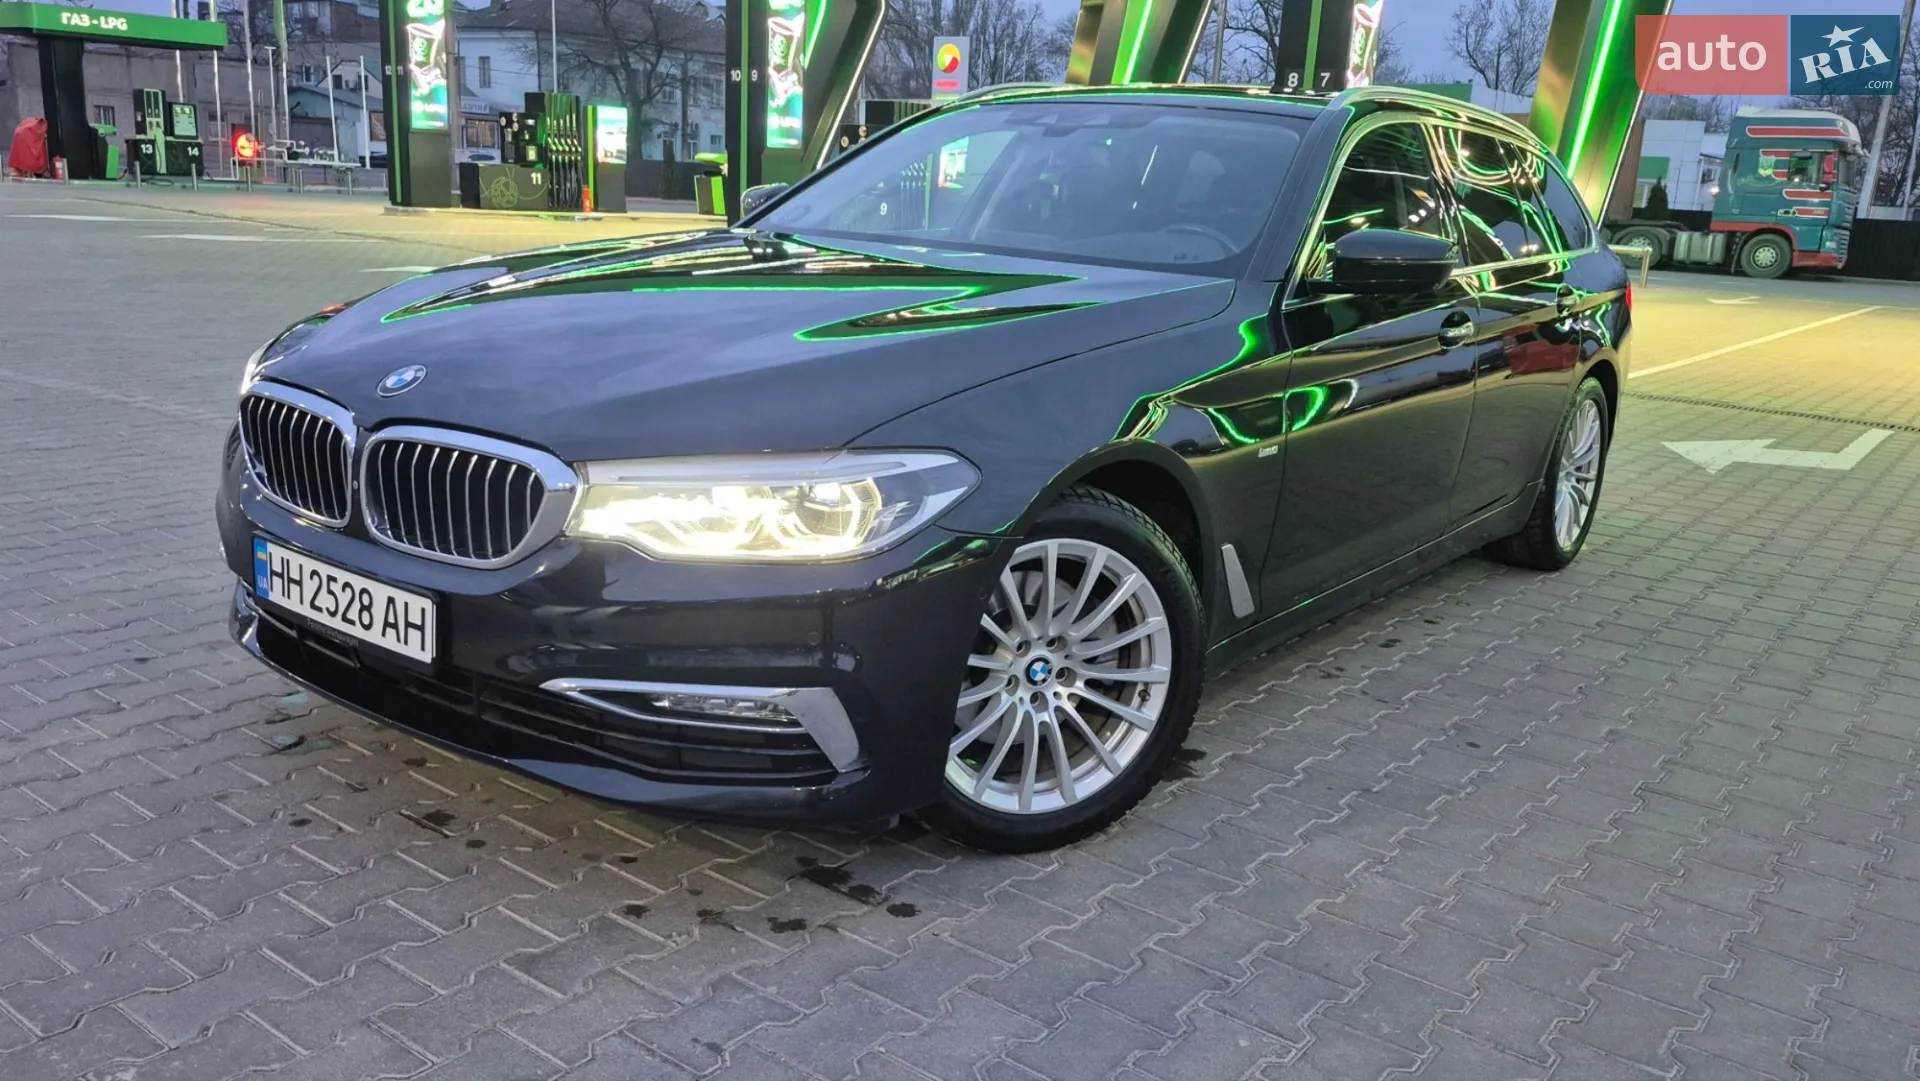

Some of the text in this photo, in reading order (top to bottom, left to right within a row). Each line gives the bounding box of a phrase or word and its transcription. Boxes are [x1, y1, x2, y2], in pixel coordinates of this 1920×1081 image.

[730, 69, 741, 82] 10
[751, 69, 758, 82] 9
[1287, 72, 1299, 87] 8
[1320, 72, 1331, 87] 7
[140, 143, 153, 154] 13
[187, 146, 199, 157] 14
[531, 172, 542, 185] 11
[880, 202, 888, 216] 9
[257, 575, 268, 590] UA
[309, 569, 374, 631] 2528
[381, 595, 426, 652] AH
